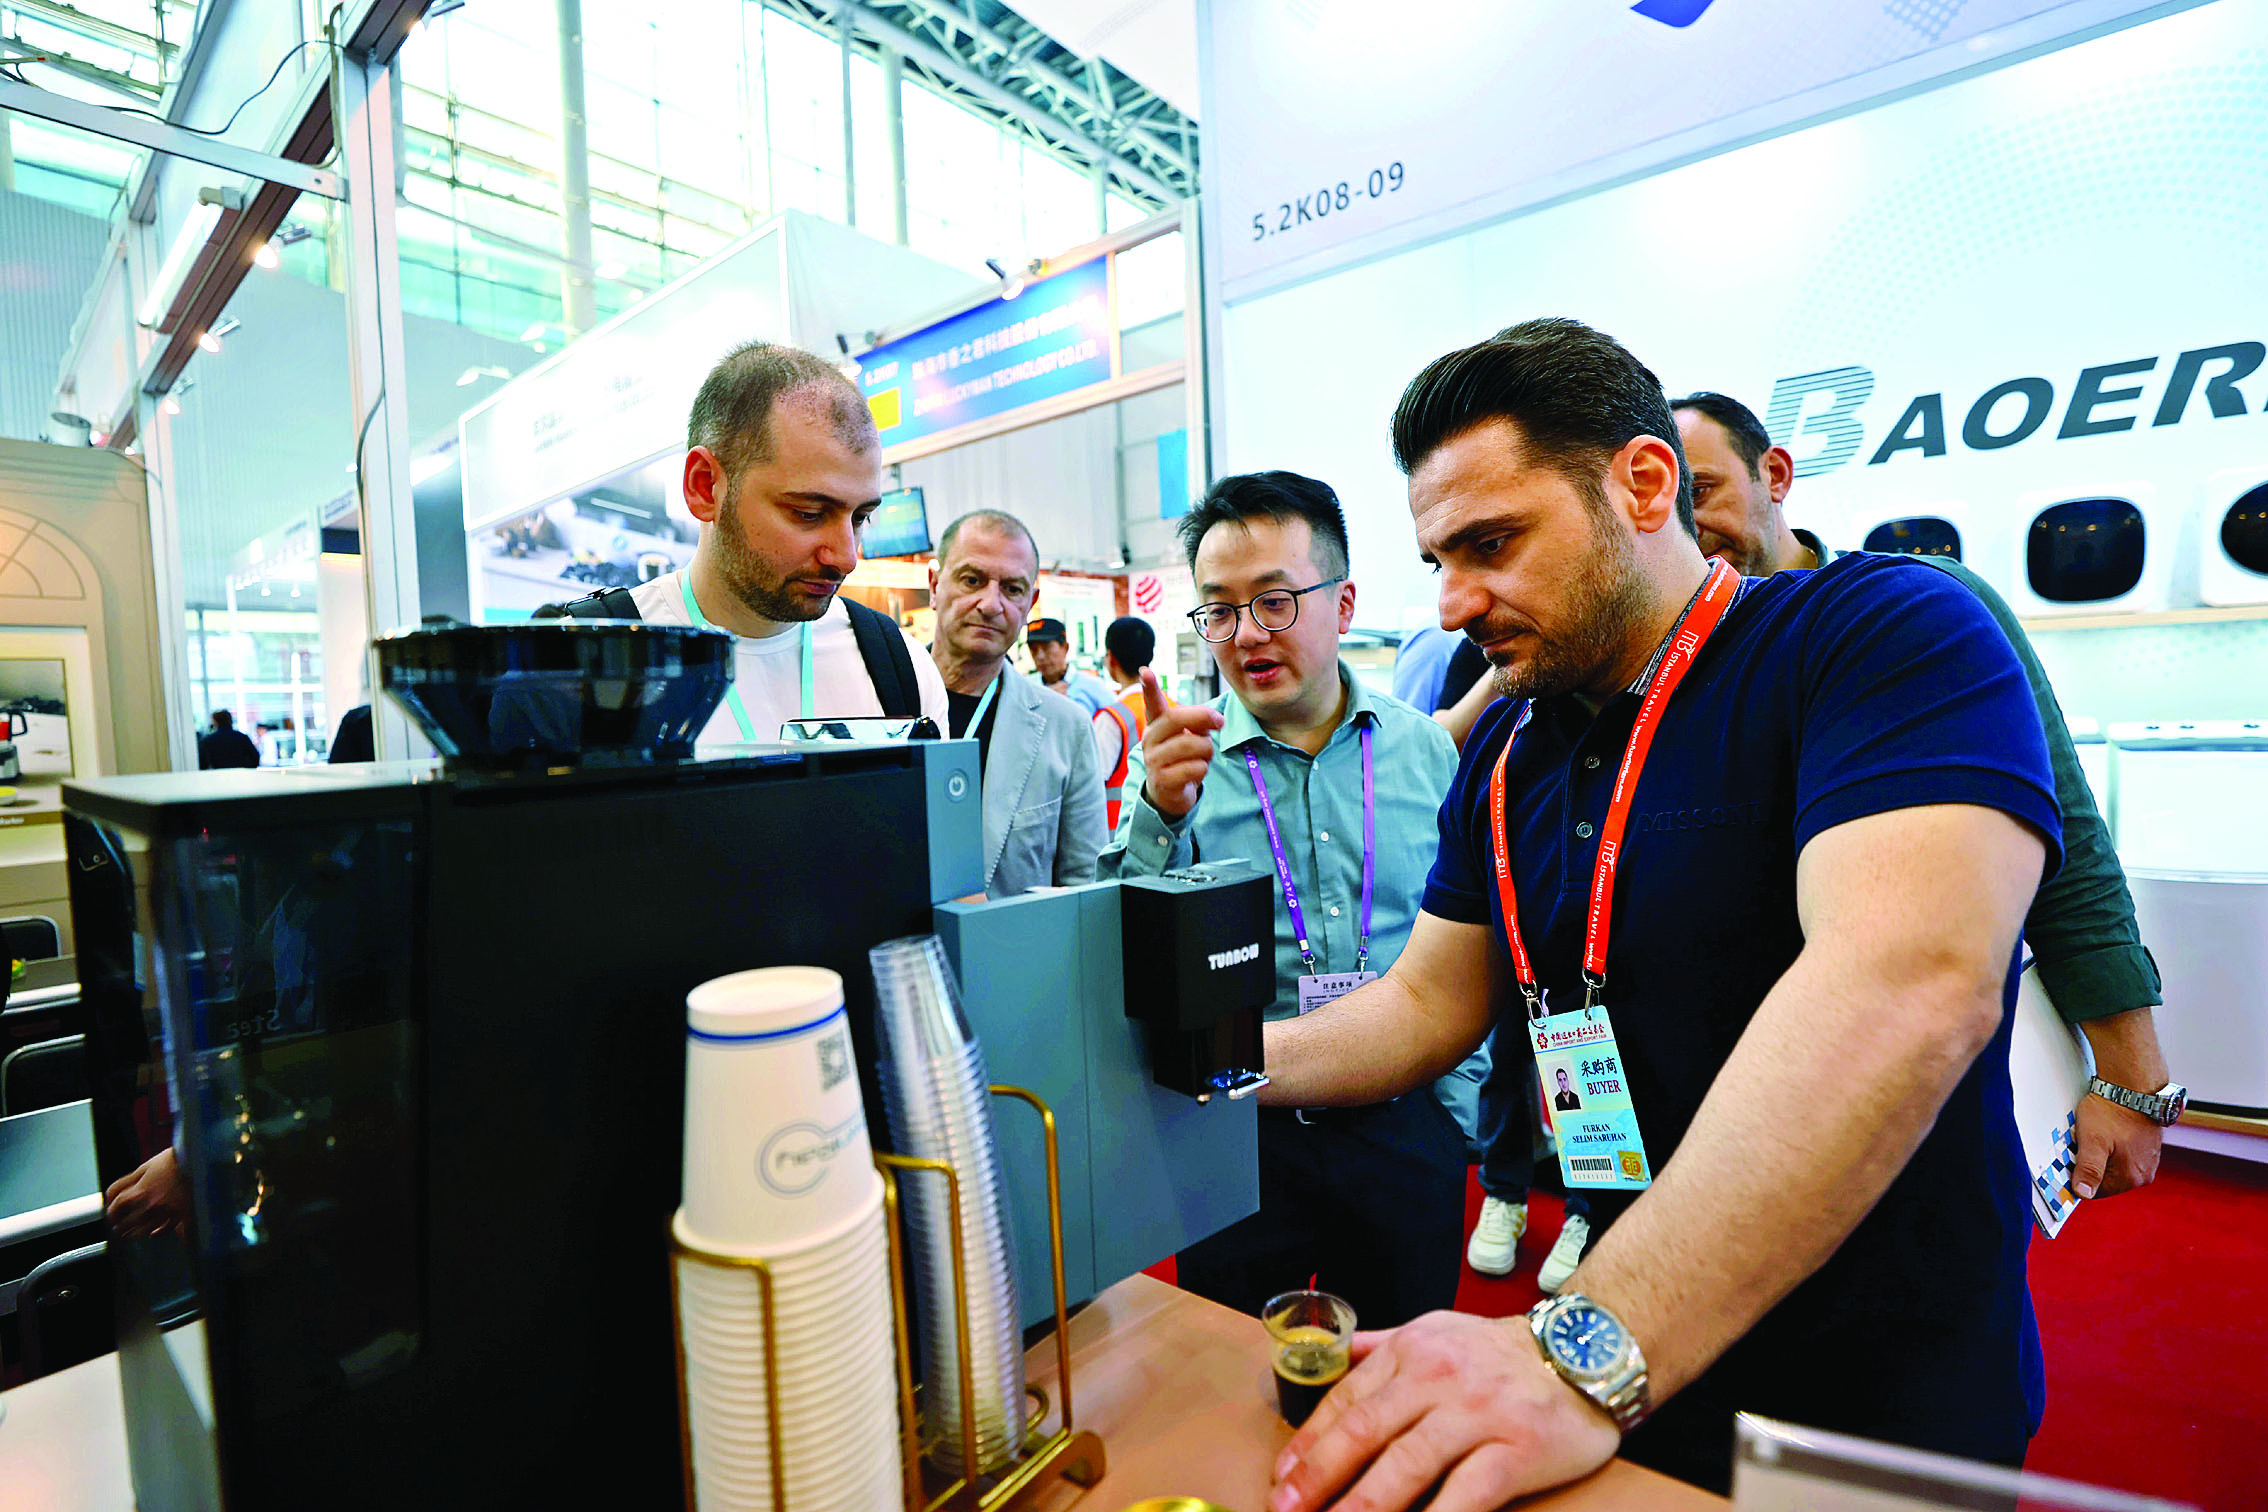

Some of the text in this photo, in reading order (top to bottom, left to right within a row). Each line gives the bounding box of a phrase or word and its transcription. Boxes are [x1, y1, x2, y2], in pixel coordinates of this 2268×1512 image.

[1253, 161, 1404, 242] 5.2K08-09
[1765, 341, 2268, 478] BAOER
[1657, 651, 1681, 686] ISTANBUL
[1640, 688, 1661, 722] TRAVEL
[1595, 865, 1608, 902] ISTANBUL
[1590, 904, 1600, 939] TRAVEL
[1581, 1056, 1618, 1077] 采购商
[1586, 1080, 1622, 1096] BUYER
[1572, 1133, 1627, 1144] SELIM SARUHAN
[1582, 1123, 1611, 1133] FURKAN
